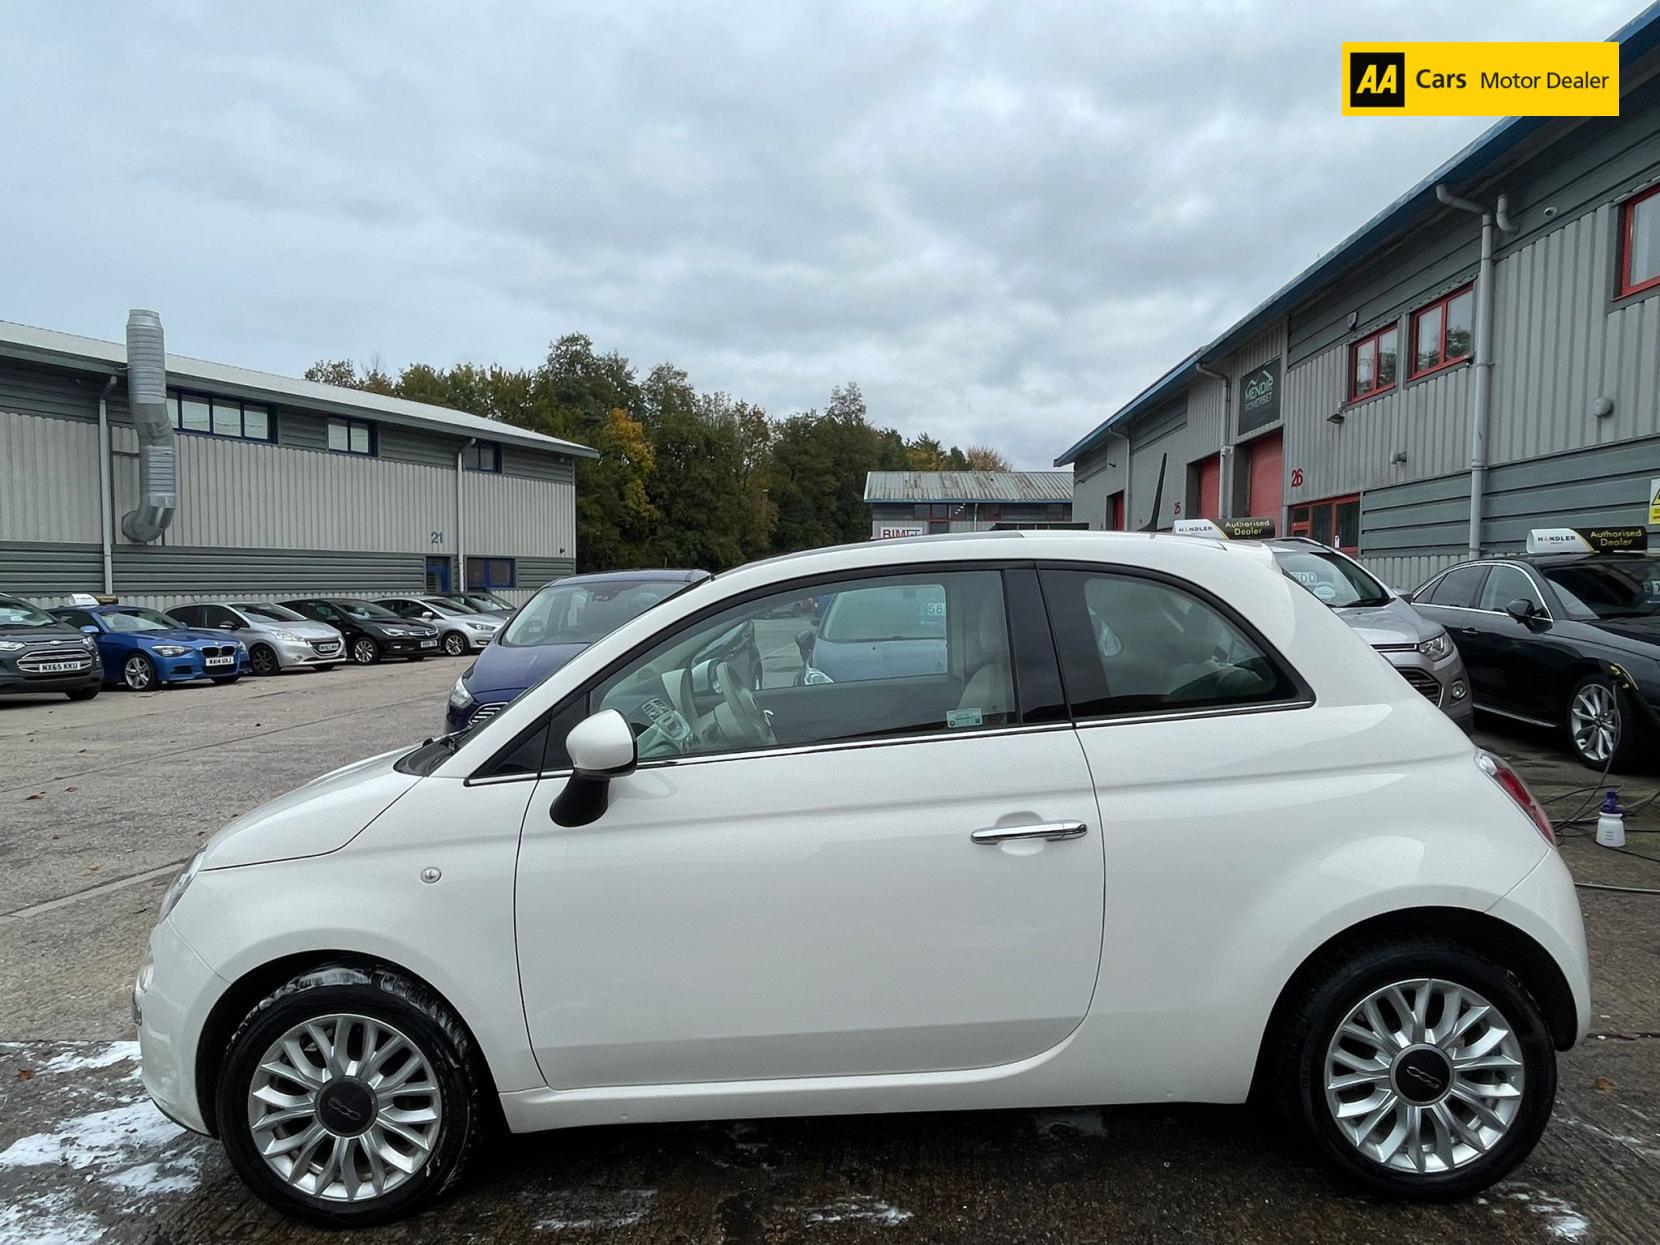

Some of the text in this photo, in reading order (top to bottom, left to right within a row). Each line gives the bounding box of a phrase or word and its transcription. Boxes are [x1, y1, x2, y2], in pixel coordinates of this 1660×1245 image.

[1291, 468, 1303, 487] 26
[1225, 519, 1270, 528] Authorised
[1234, 527, 1262, 536] Dealer
[1590, 529, 1642, 538] Authorised
[431, 531, 443, 544] 21
[1600, 538, 1633, 547] Dealer
